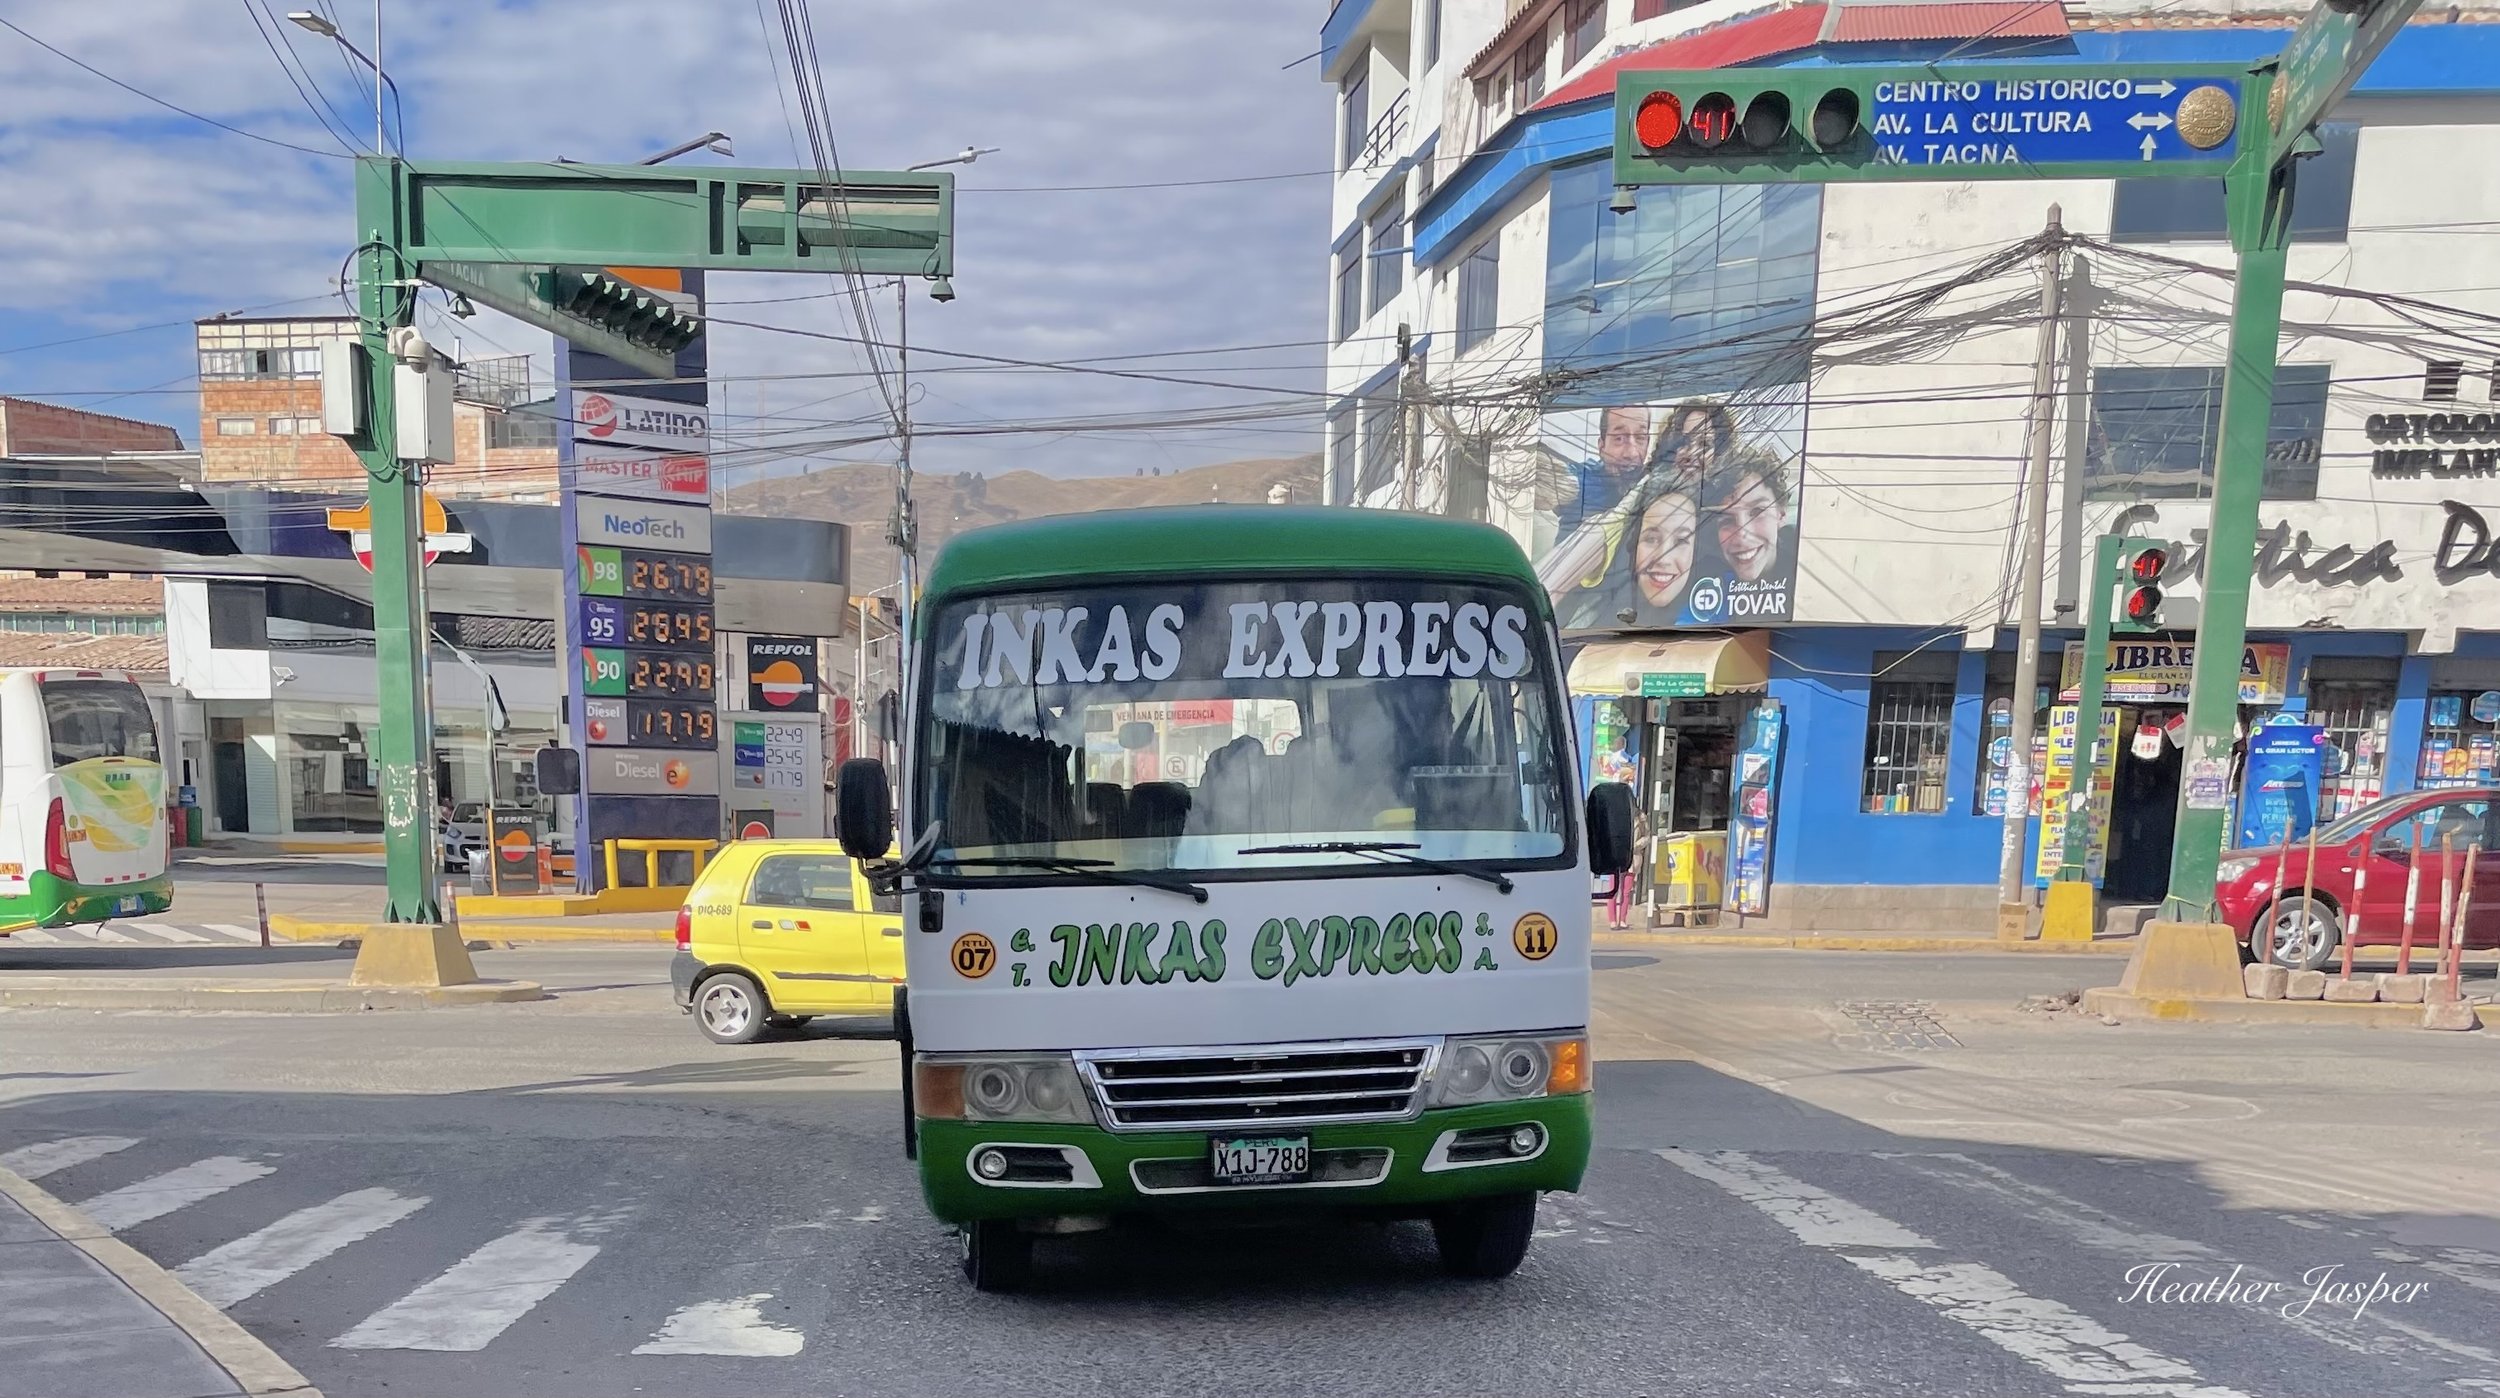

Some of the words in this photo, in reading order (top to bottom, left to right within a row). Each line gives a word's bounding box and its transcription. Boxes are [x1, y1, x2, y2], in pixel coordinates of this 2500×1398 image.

[1874, 80, 1981, 103] CENTRO
[1994, 78, 2132, 103] HISTORICO
[1693, 111, 1727, 141] 41
[1873, 113, 1912, 135] AV.
[1924, 112, 1959, 134] LA
[1972, 111, 2092, 134] CULTURA
[1872, 144, 1909, 166] AV.
[1923, 144, 2021, 166] TACNA
[585, 457, 652, 477] MASTER
[604, 514, 685, 539] NeoTech
[594, 561, 618, 581] 98
[1760, 577, 1787, 591] Dental
[1727, 593, 1787, 616] TOVAR
[590, 617, 615, 638] 95
[752, 644, 813, 656] REPSOL
[956, 602, 1185, 690] INKAS
[1221, 600, 1528, 680] EXPRESS
[596, 660, 620, 680] 90
[586, 705, 620, 718] Diesel
[1154, 710, 1165, 721] DE
[615, 761, 660, 778] Diesel
[496, 816, 533, 824] REPSOL
[1475, 912, 1495, 936] S.
[1048, 918, 1228, 988] INKAS
[1251, 909, 1464, 988] EXPRESS
[1524, 927, 1547, 953] 11
[958, 948, 991, 971] 07
[1011, 963, 1031, 987] T.
[1216, 1147, 1307, 1175] X1J-788
